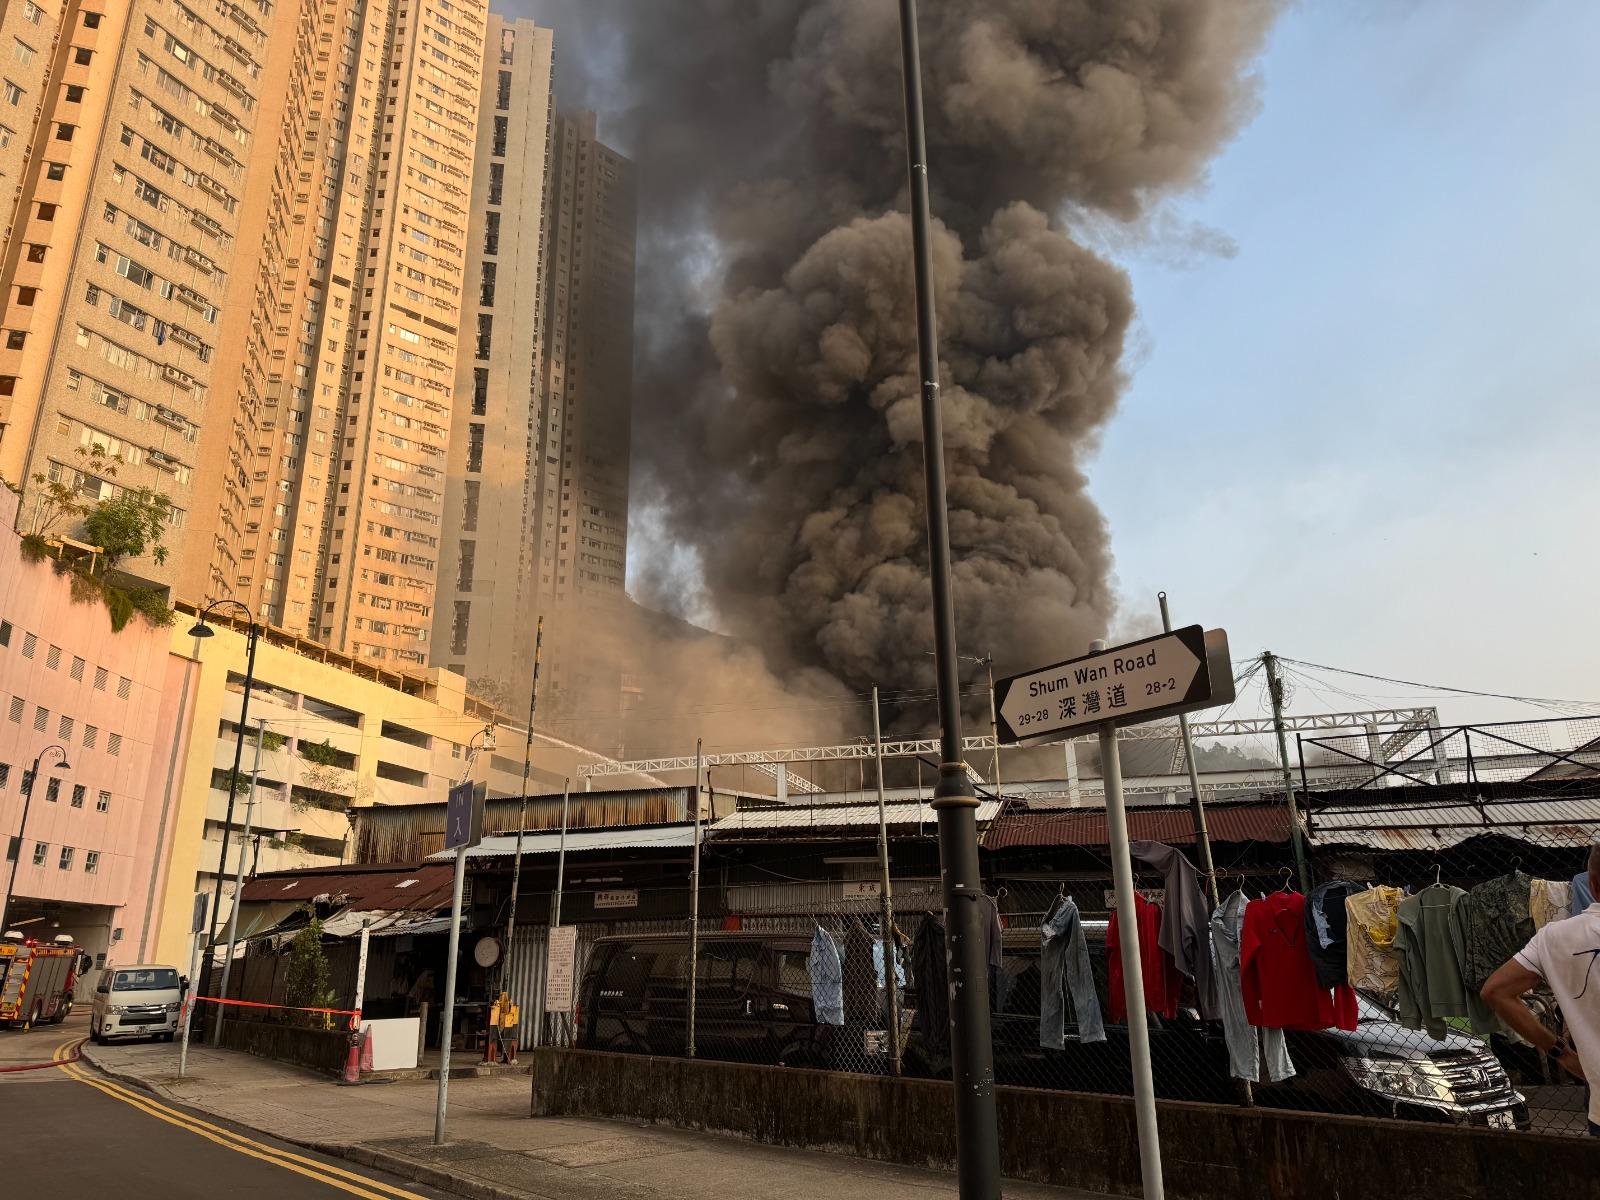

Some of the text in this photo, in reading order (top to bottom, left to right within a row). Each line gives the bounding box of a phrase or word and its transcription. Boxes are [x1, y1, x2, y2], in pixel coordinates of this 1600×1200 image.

[1029, 649, 1157, 698] Shum Wan Road
[1018, 677, 1176, 726] 29-28 深灣道 28-2
[453, 816, 462, 838] 入
